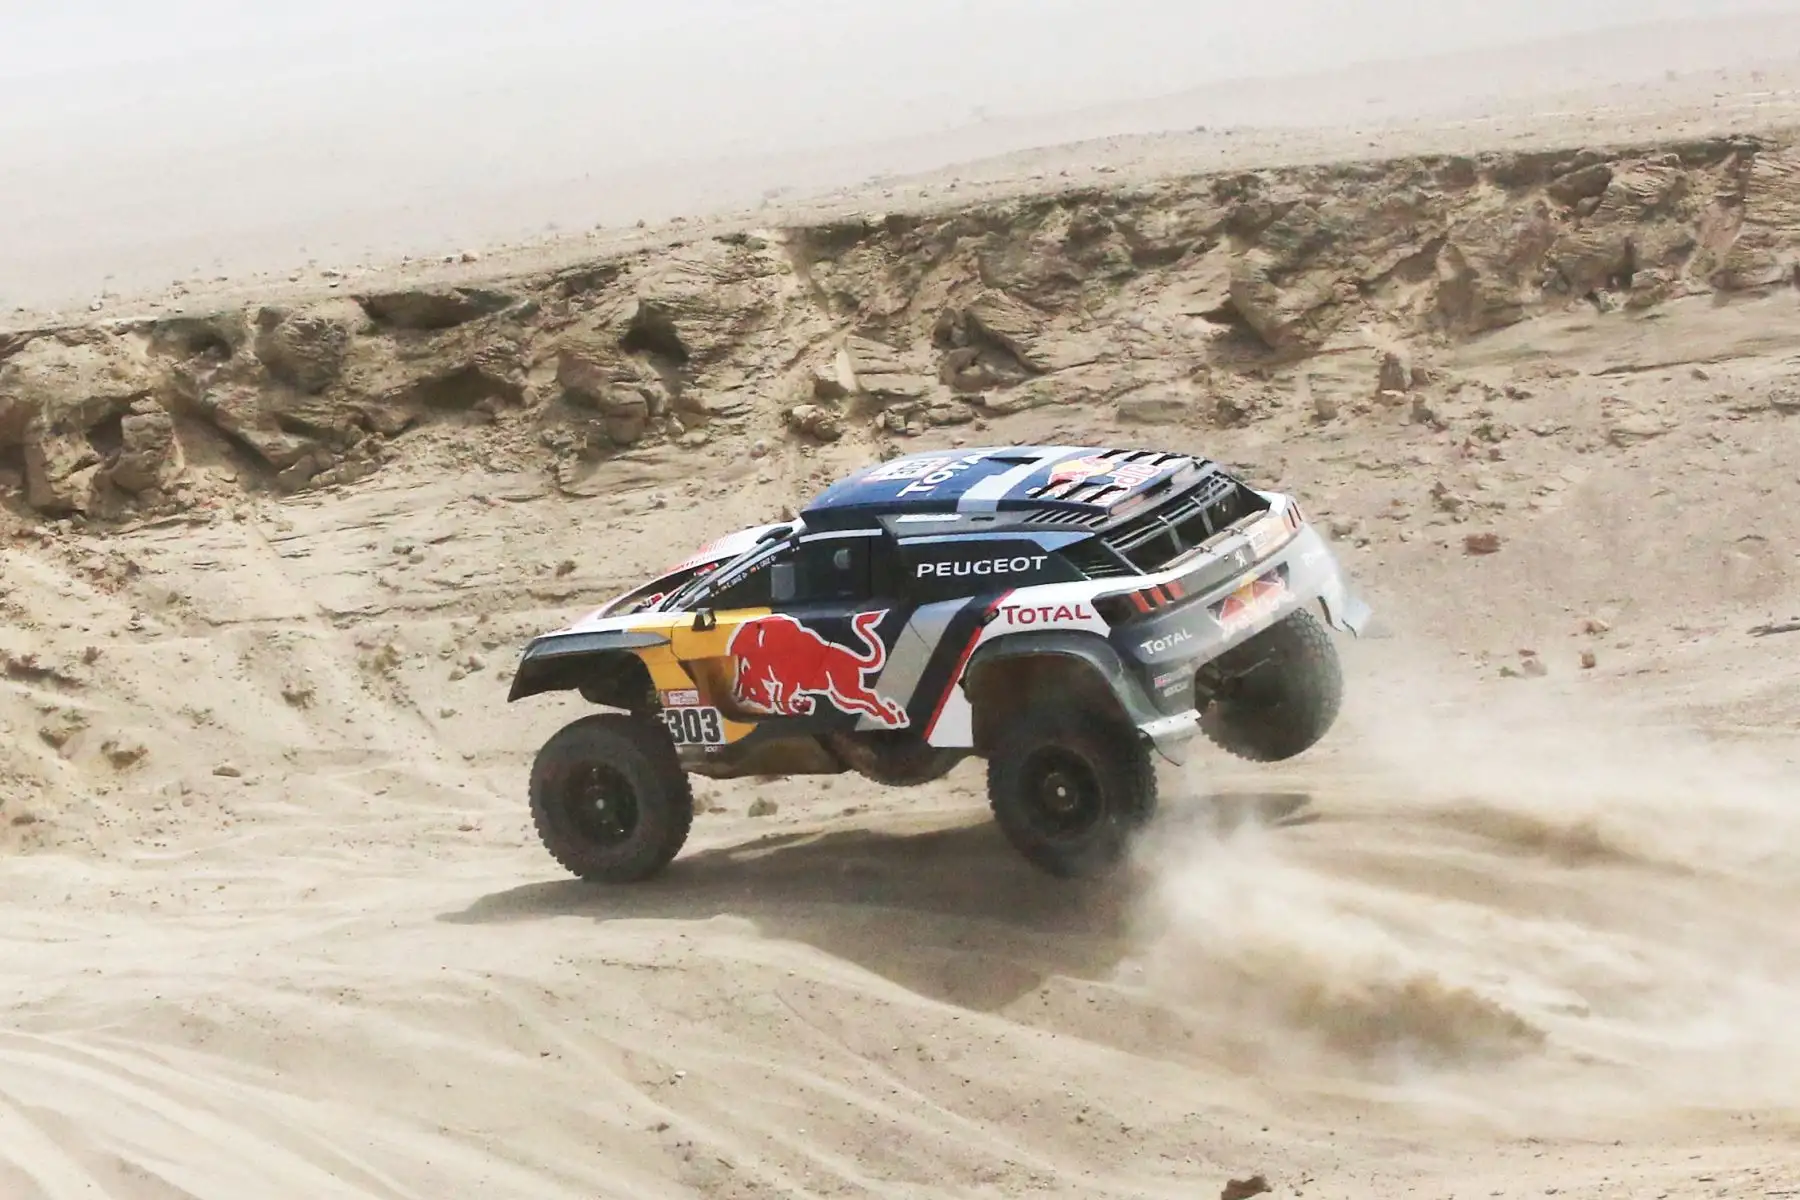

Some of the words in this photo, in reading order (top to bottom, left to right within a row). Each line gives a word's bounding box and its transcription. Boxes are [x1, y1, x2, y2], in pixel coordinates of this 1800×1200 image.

[917, 555, 1048, 578] PEUGEOT
[1002, 604, 1091, 625] TOTAL
[1140, 628, 1193, 655] TOTAL
[665, 708, 721, 743] 303
